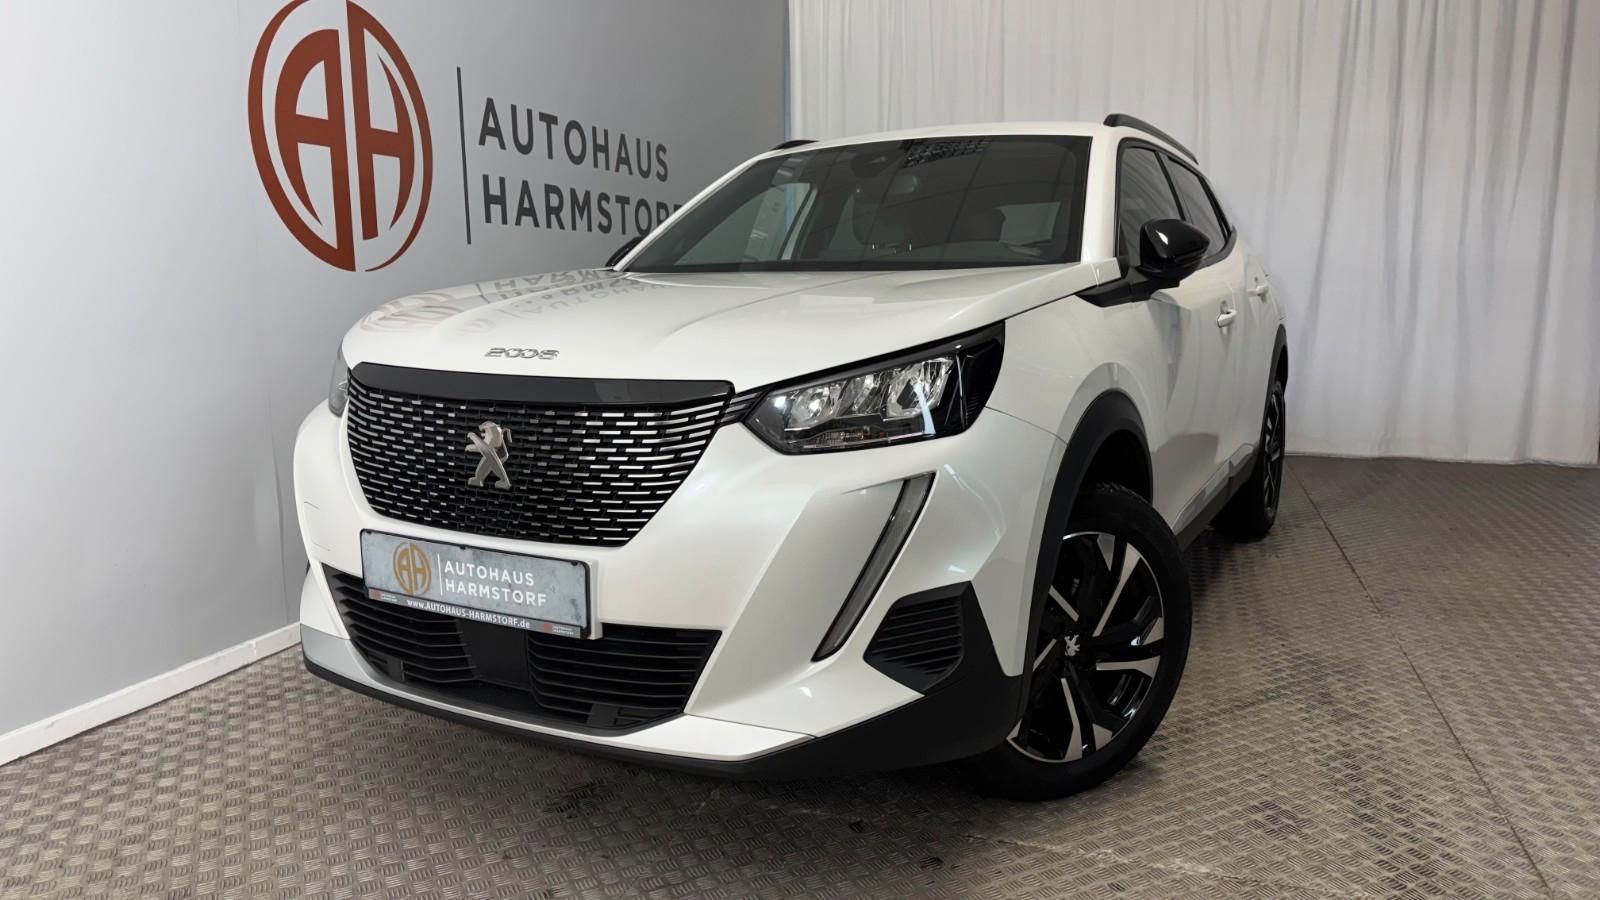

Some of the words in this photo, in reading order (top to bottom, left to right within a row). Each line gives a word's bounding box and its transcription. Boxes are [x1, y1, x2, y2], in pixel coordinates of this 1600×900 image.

[478, 97, 669, 183] AUTOHAUS
[482, 174, 684, 238] HARMSTOR
[484, 347, 560, 361] 2008
[444, 560, 535, 587] AUTOHAUS
[445, 578, 547, 607] HARMSTORF
[406, 599, 531, 629] www.AUTOHAUS-HARMSTORF.de
